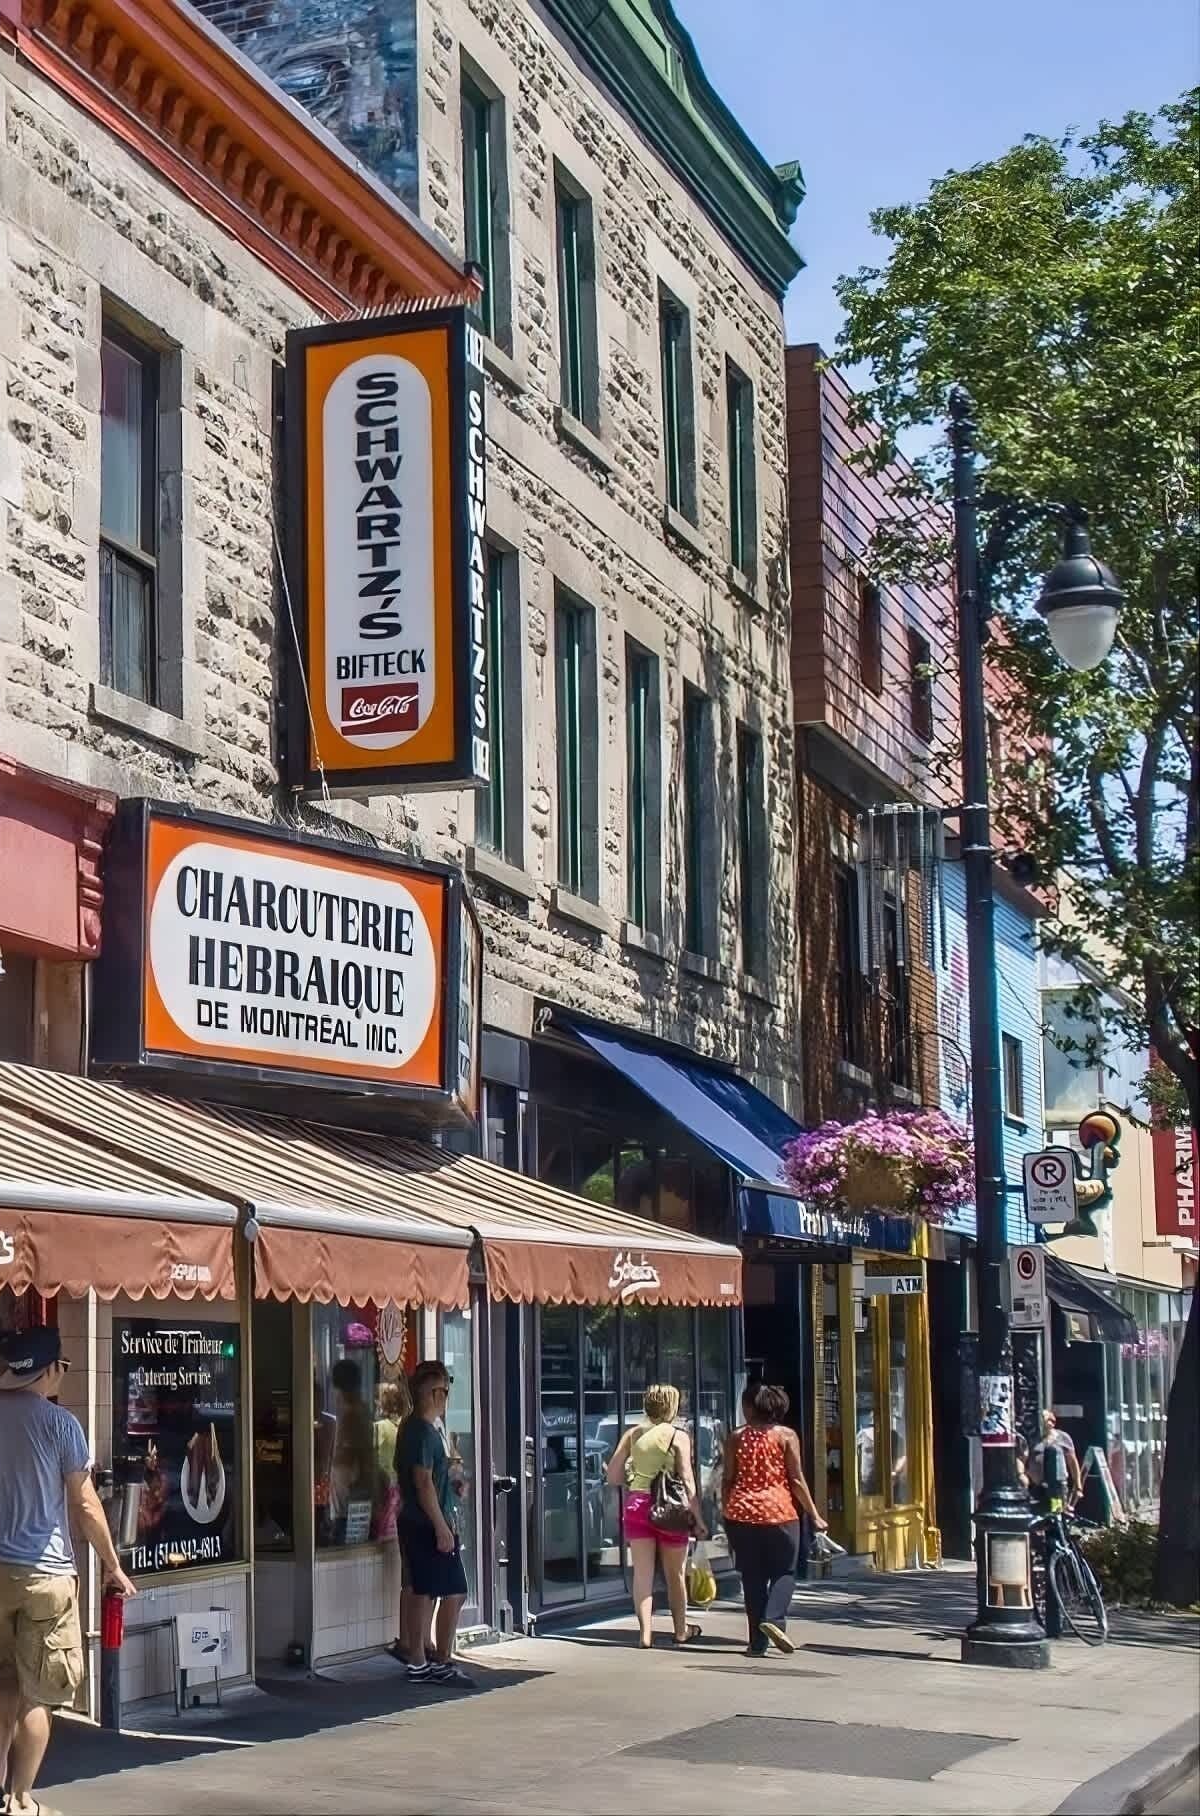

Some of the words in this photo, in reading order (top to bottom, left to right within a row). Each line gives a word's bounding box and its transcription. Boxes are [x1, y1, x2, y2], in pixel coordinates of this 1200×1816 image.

[355, 371, 403, 641] SCHWARTZ'S
[466, 389, 487, 729] SCHWARTZ'S
[336, 648, 426, 680] BIFTECK
[176, 865, 415, 957] CHARCUTERIE
[196, 998, 229, 1030] DE
[366, 1023, 404, 1055] INC.
[895, 1278, 922, 1292] ATM
[121, 1331, 162, 1354] Service
[164, 1332, 178, 1354] de
[138, 1366, 178, 1391] Catering
[179, 1366, 211, 1385] Service
